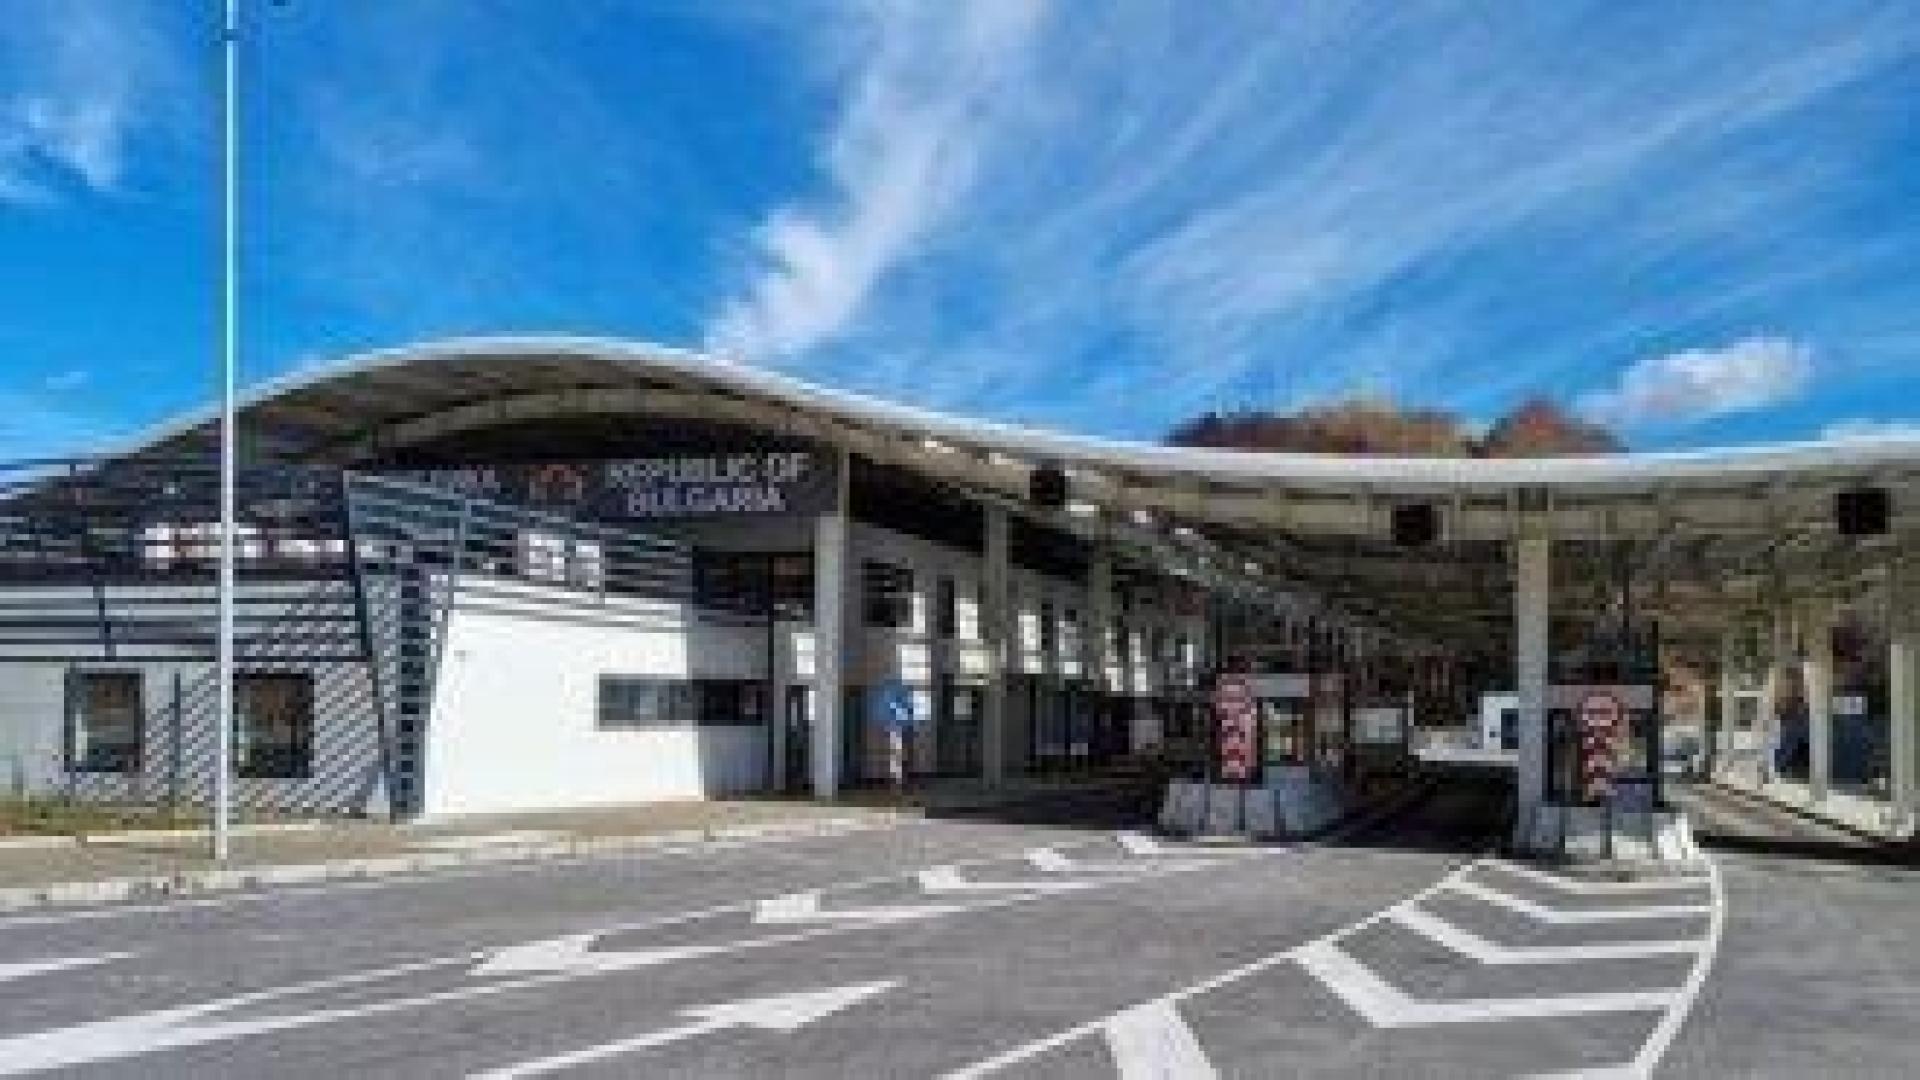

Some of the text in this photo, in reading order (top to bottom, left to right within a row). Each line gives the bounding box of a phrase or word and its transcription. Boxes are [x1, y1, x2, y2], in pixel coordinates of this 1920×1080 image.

[606, 453, 809, 488] REPUBLIC OF
[627, 487, 786, 515] BULGARIA
